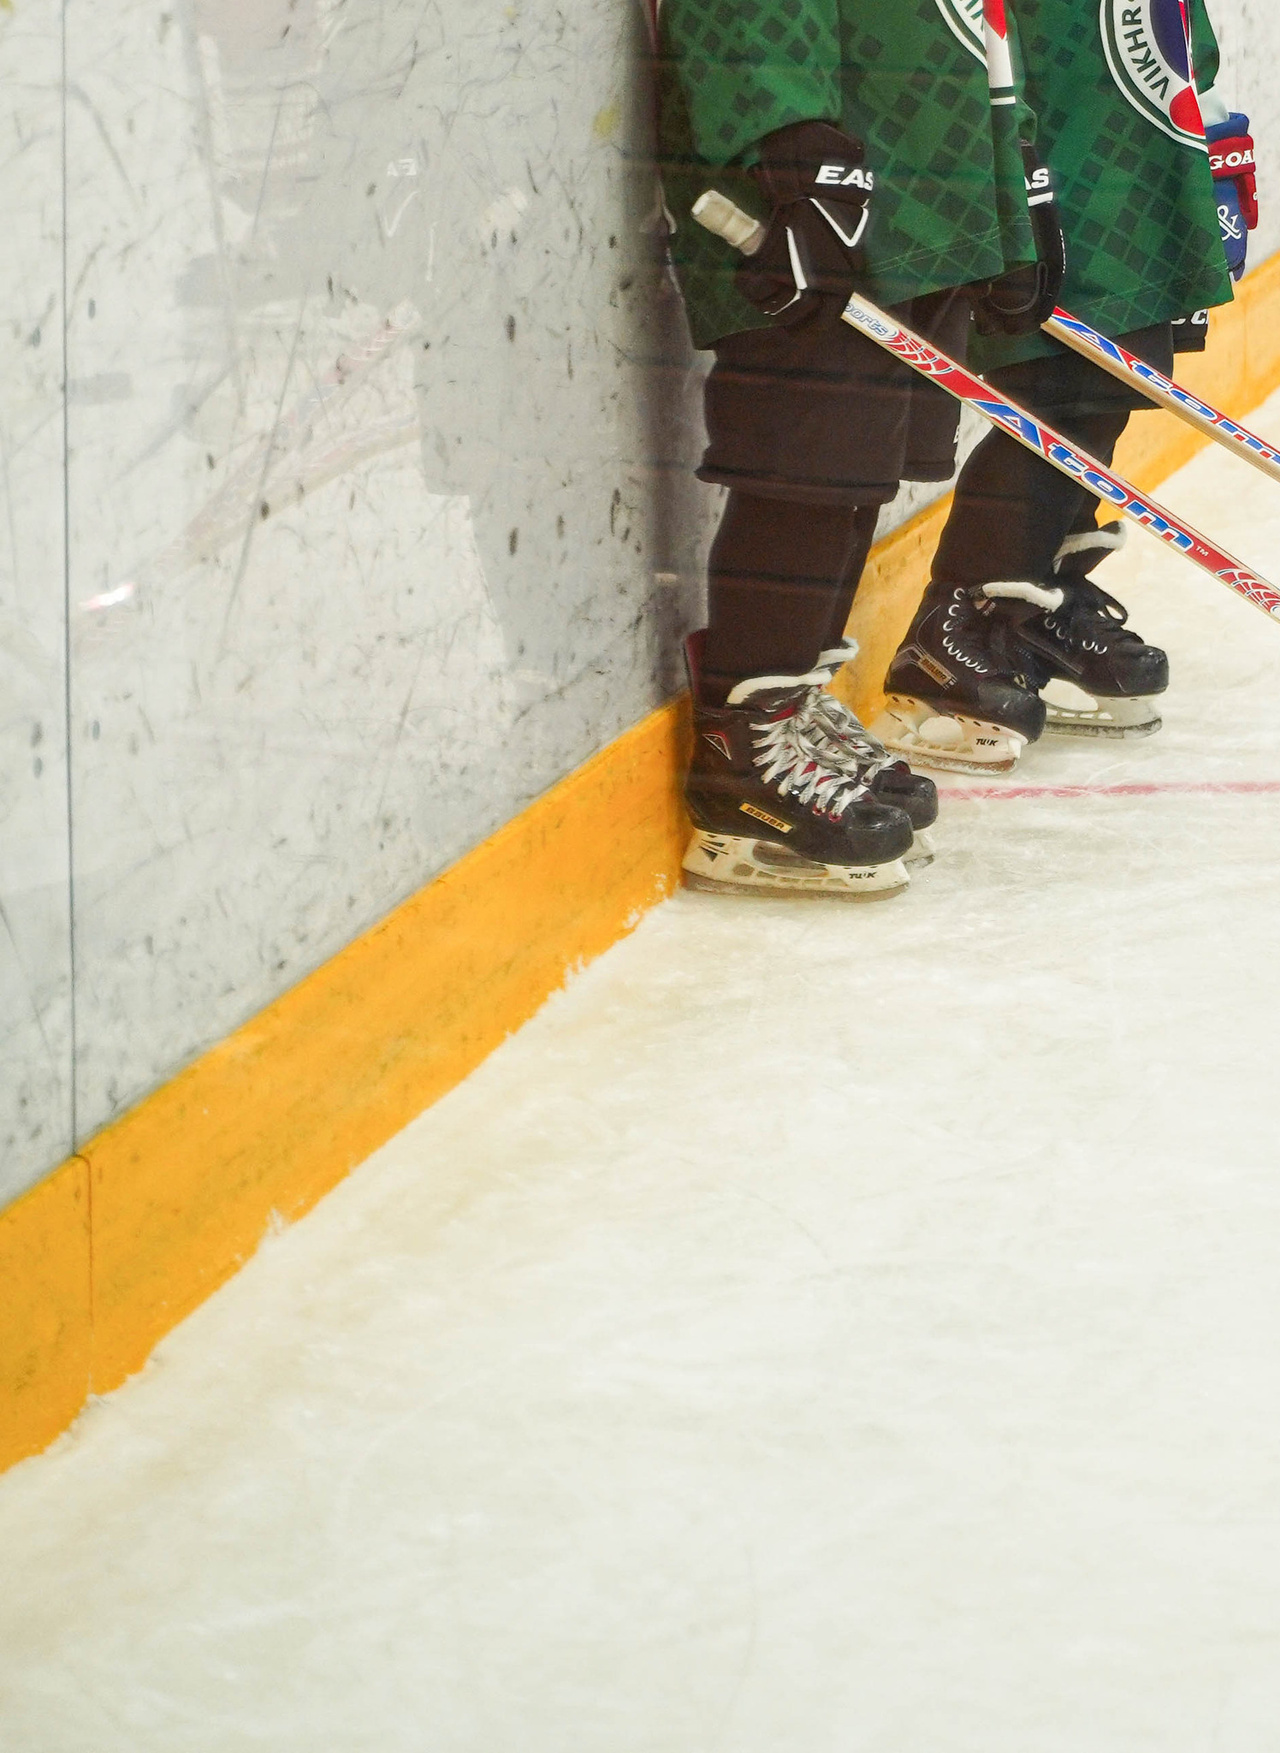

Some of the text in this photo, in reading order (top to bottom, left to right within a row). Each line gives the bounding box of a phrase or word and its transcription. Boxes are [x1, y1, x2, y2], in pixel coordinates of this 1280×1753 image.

[1121, 6, 1170, 100] VIKHR
[969, 397, 1194, 553] Atom
[745, 805, 785, 830] BAUER
